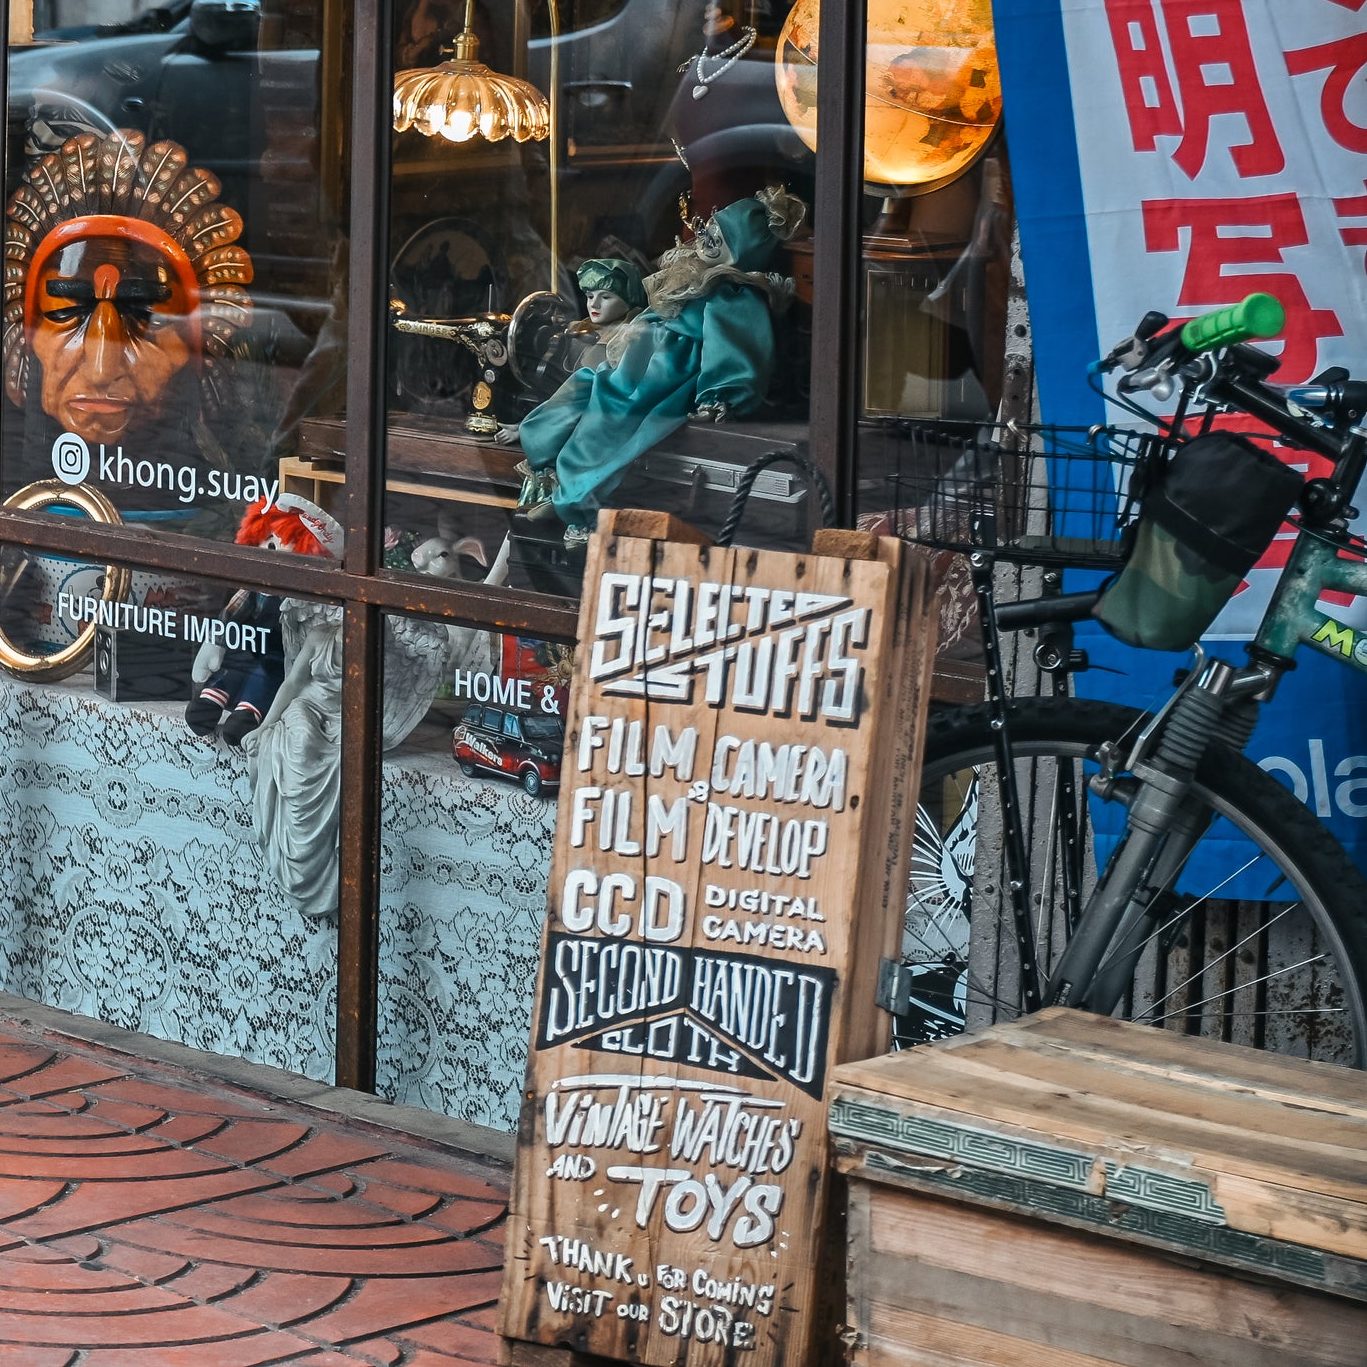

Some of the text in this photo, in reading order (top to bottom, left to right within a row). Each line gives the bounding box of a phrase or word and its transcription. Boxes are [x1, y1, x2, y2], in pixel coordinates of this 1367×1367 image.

[99, 443, 279, 514] khong.suay
[58, 592, 271, 655] FURNITURE IMPORT
[590, 571, 855, 680] SELECTED
[454, 668, 560, 715] HOME &
[601, 607, 868, 719] STUFFS
[466, 732, 503, 767] Walkers
[577, 715, 848, 812] FILM CAMERA
[570, 785, 828, 879] FILM DEVELOP
[561, 868, 826, 943] CCD DIGITAL
[701, 918, 826, 955] CAMERA
[546, 938, 825, 1085] SECOND HANDED
[601, 1014, 740, 1072] CLOTH
[667, 1093, 803, 1175] WATCHES
[546, 1154, 784, 1248] AND TOYS
[539, 1235, 634, 1285] THANK
[656, 1264, 688, 1290] FOR
[616, 1303, 650, 1322] OUR
[658, 1296, 756, 1349] STORE
